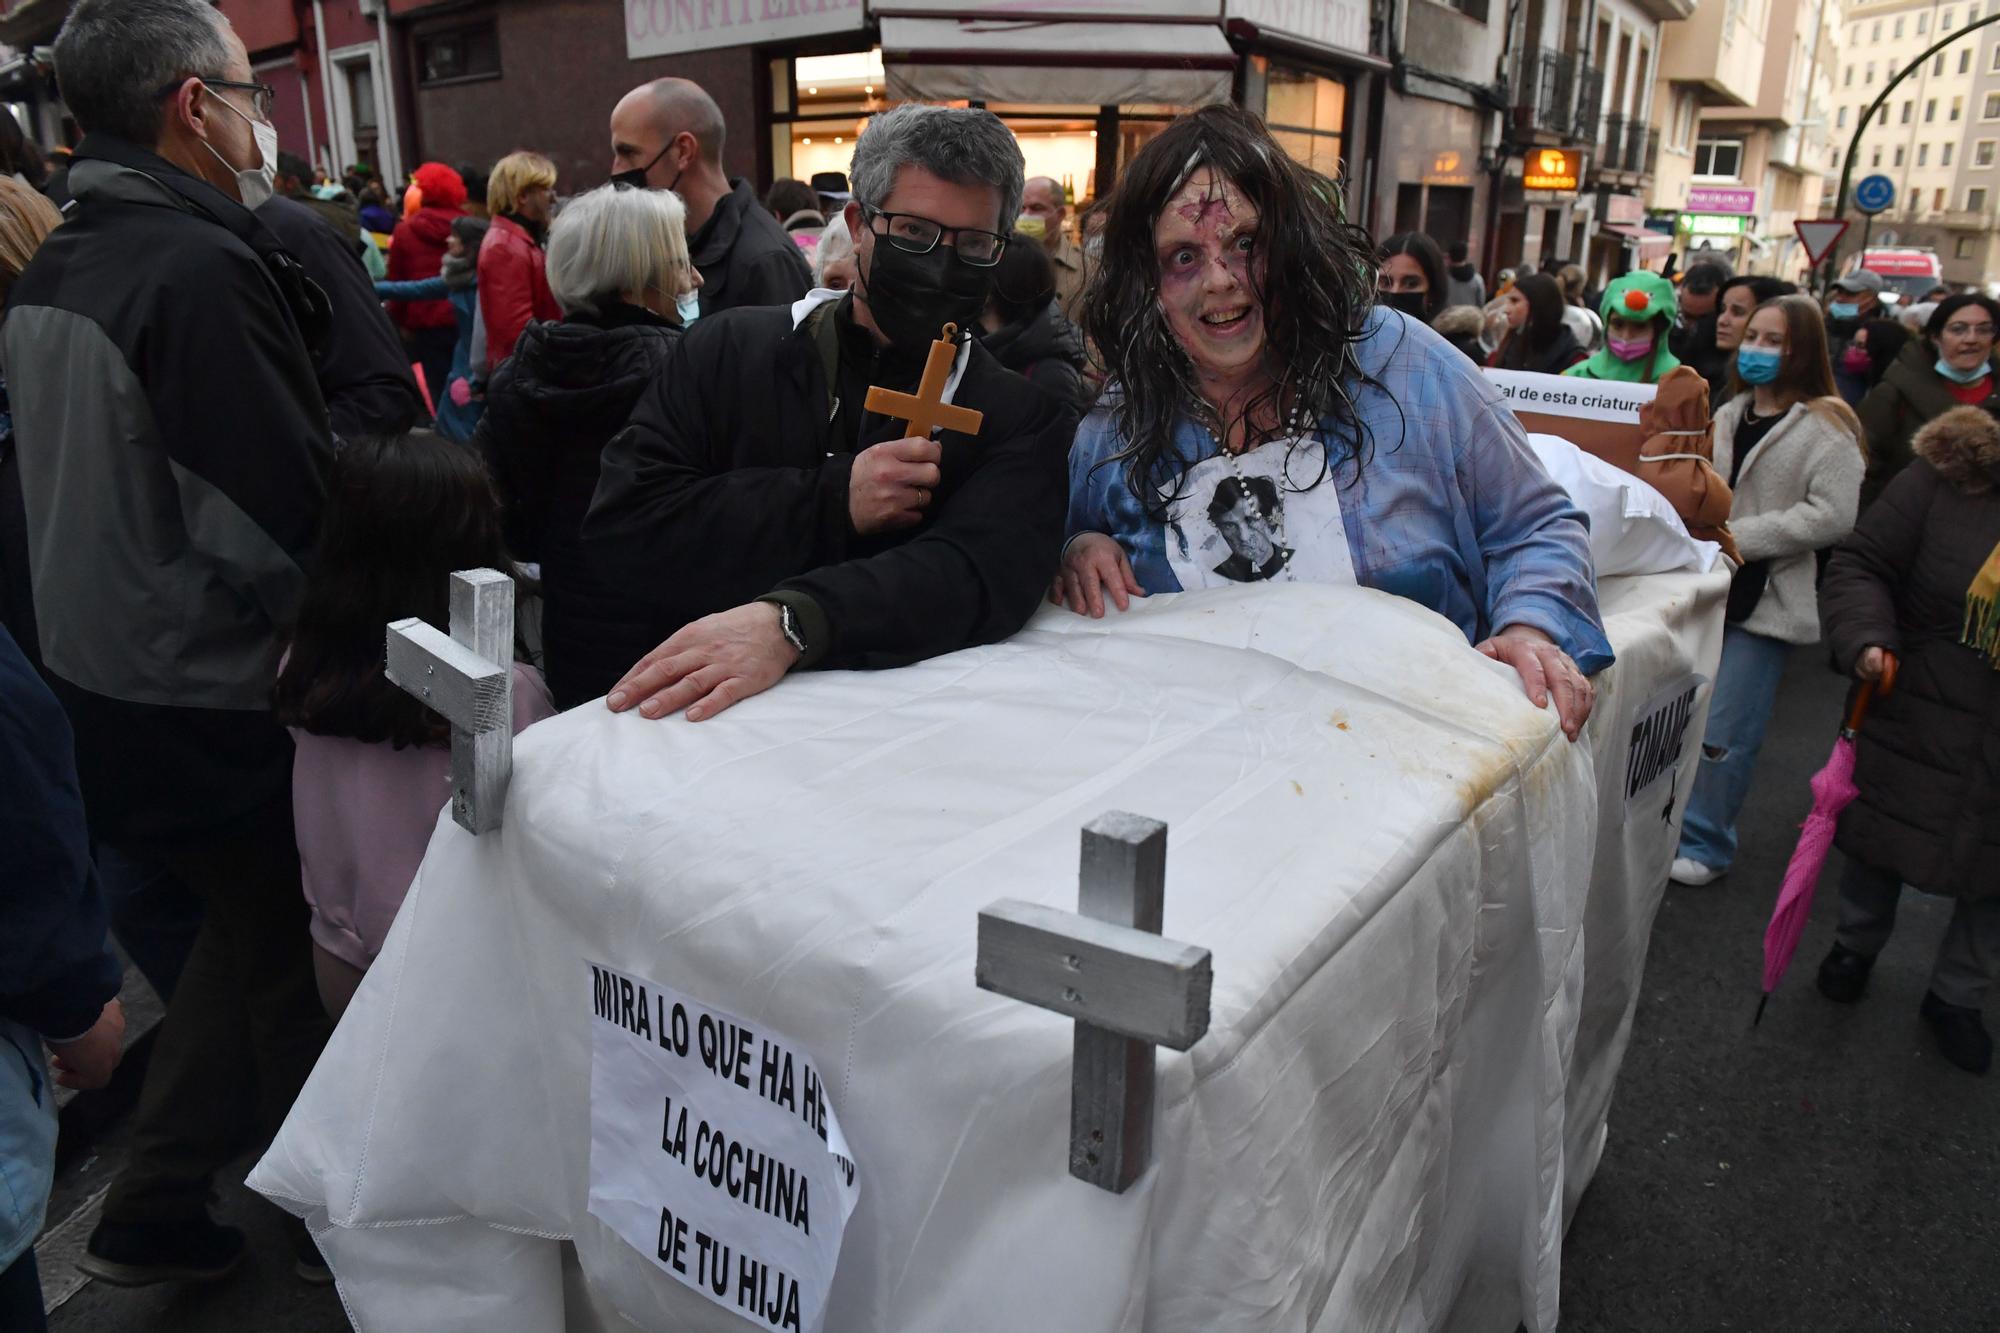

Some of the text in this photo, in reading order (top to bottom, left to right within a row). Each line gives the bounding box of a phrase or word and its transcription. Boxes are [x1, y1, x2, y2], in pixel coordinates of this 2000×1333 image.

[1519, 386, 1538, 401] de
[1542, 391, 1577, 405] esta
[591, 965, 651, 1041] MIRA
[657, 994, 689, 1058] LO
[698, 1013, 753, 1090] QUE
[759, 1039, 795, 1114] HA
[662, 1096, 810, 1237] LA COCHINA
[657, 1206, 801, 1333] DE TU HIJA
